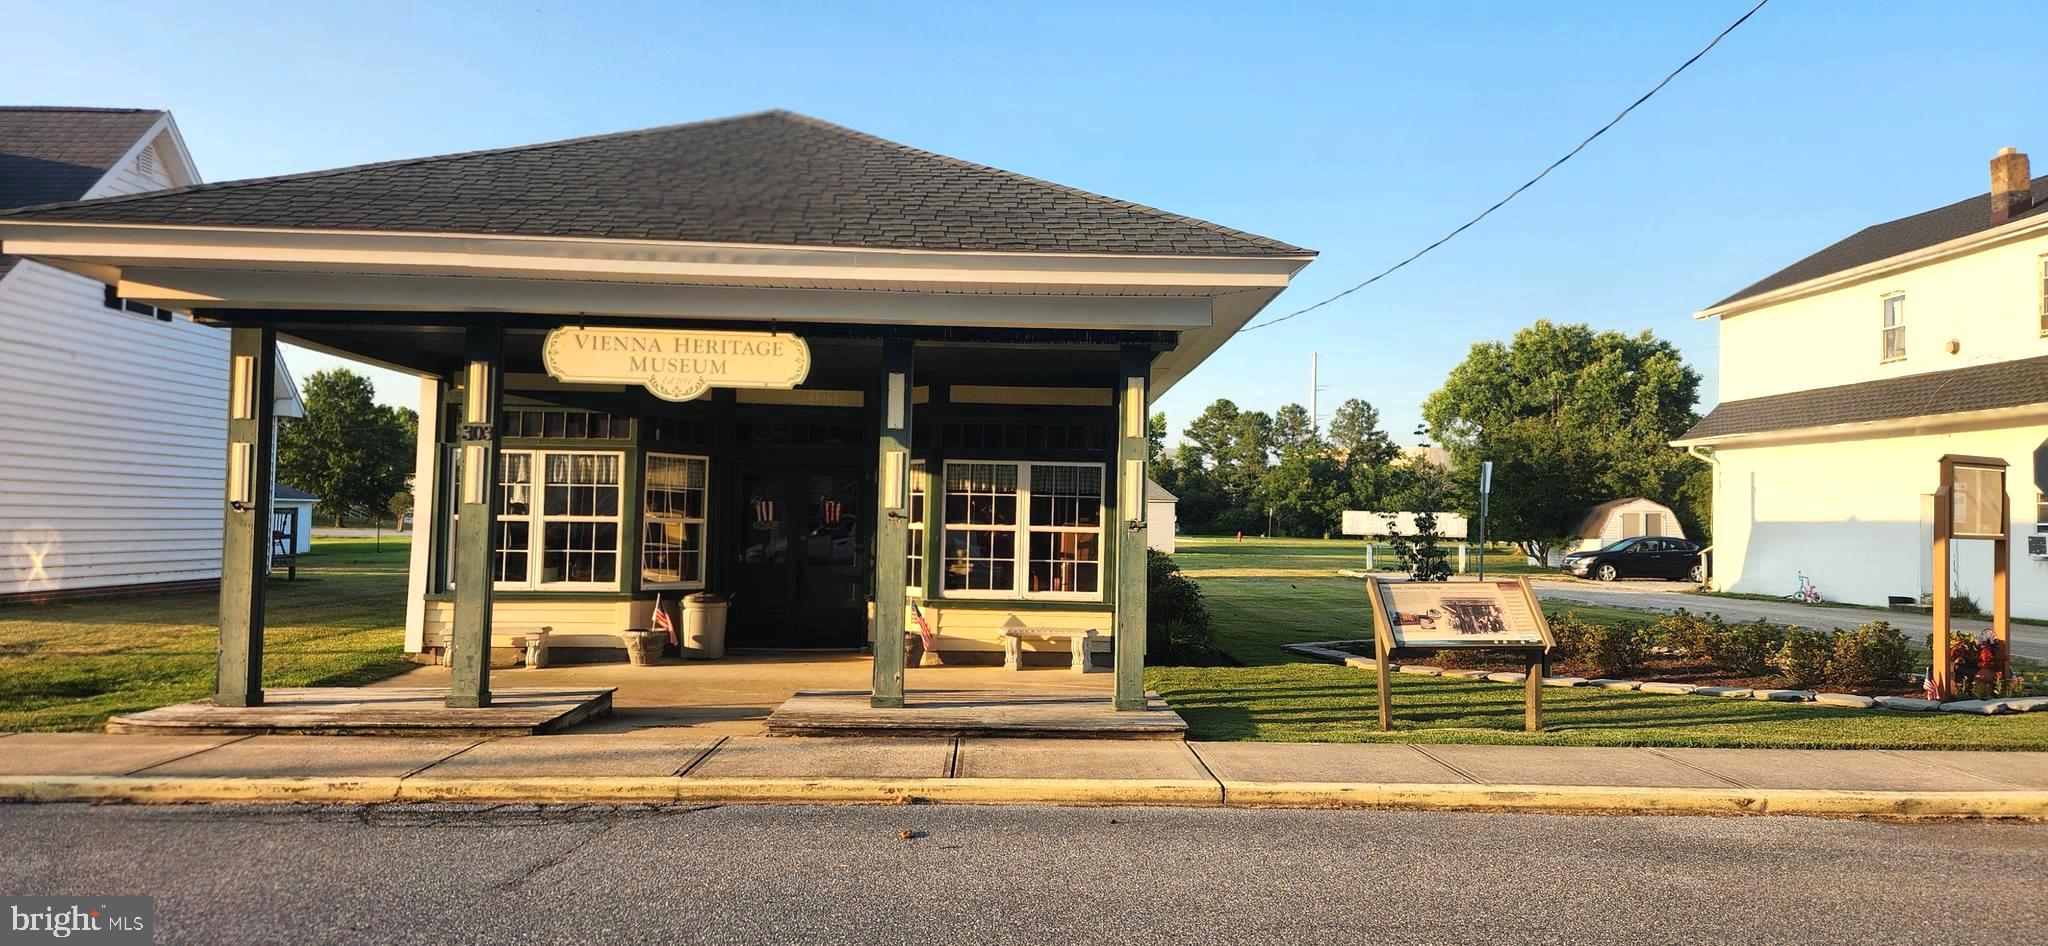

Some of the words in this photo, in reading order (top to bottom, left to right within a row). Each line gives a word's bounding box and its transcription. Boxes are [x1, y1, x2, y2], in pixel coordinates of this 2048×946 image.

[574, 334, 662, 352] VIENNA
[674, 338, 784, 357] HERITAGE
[629, 356, 728, 374] MUSEUM
[462, 425, 493, 440] 303
